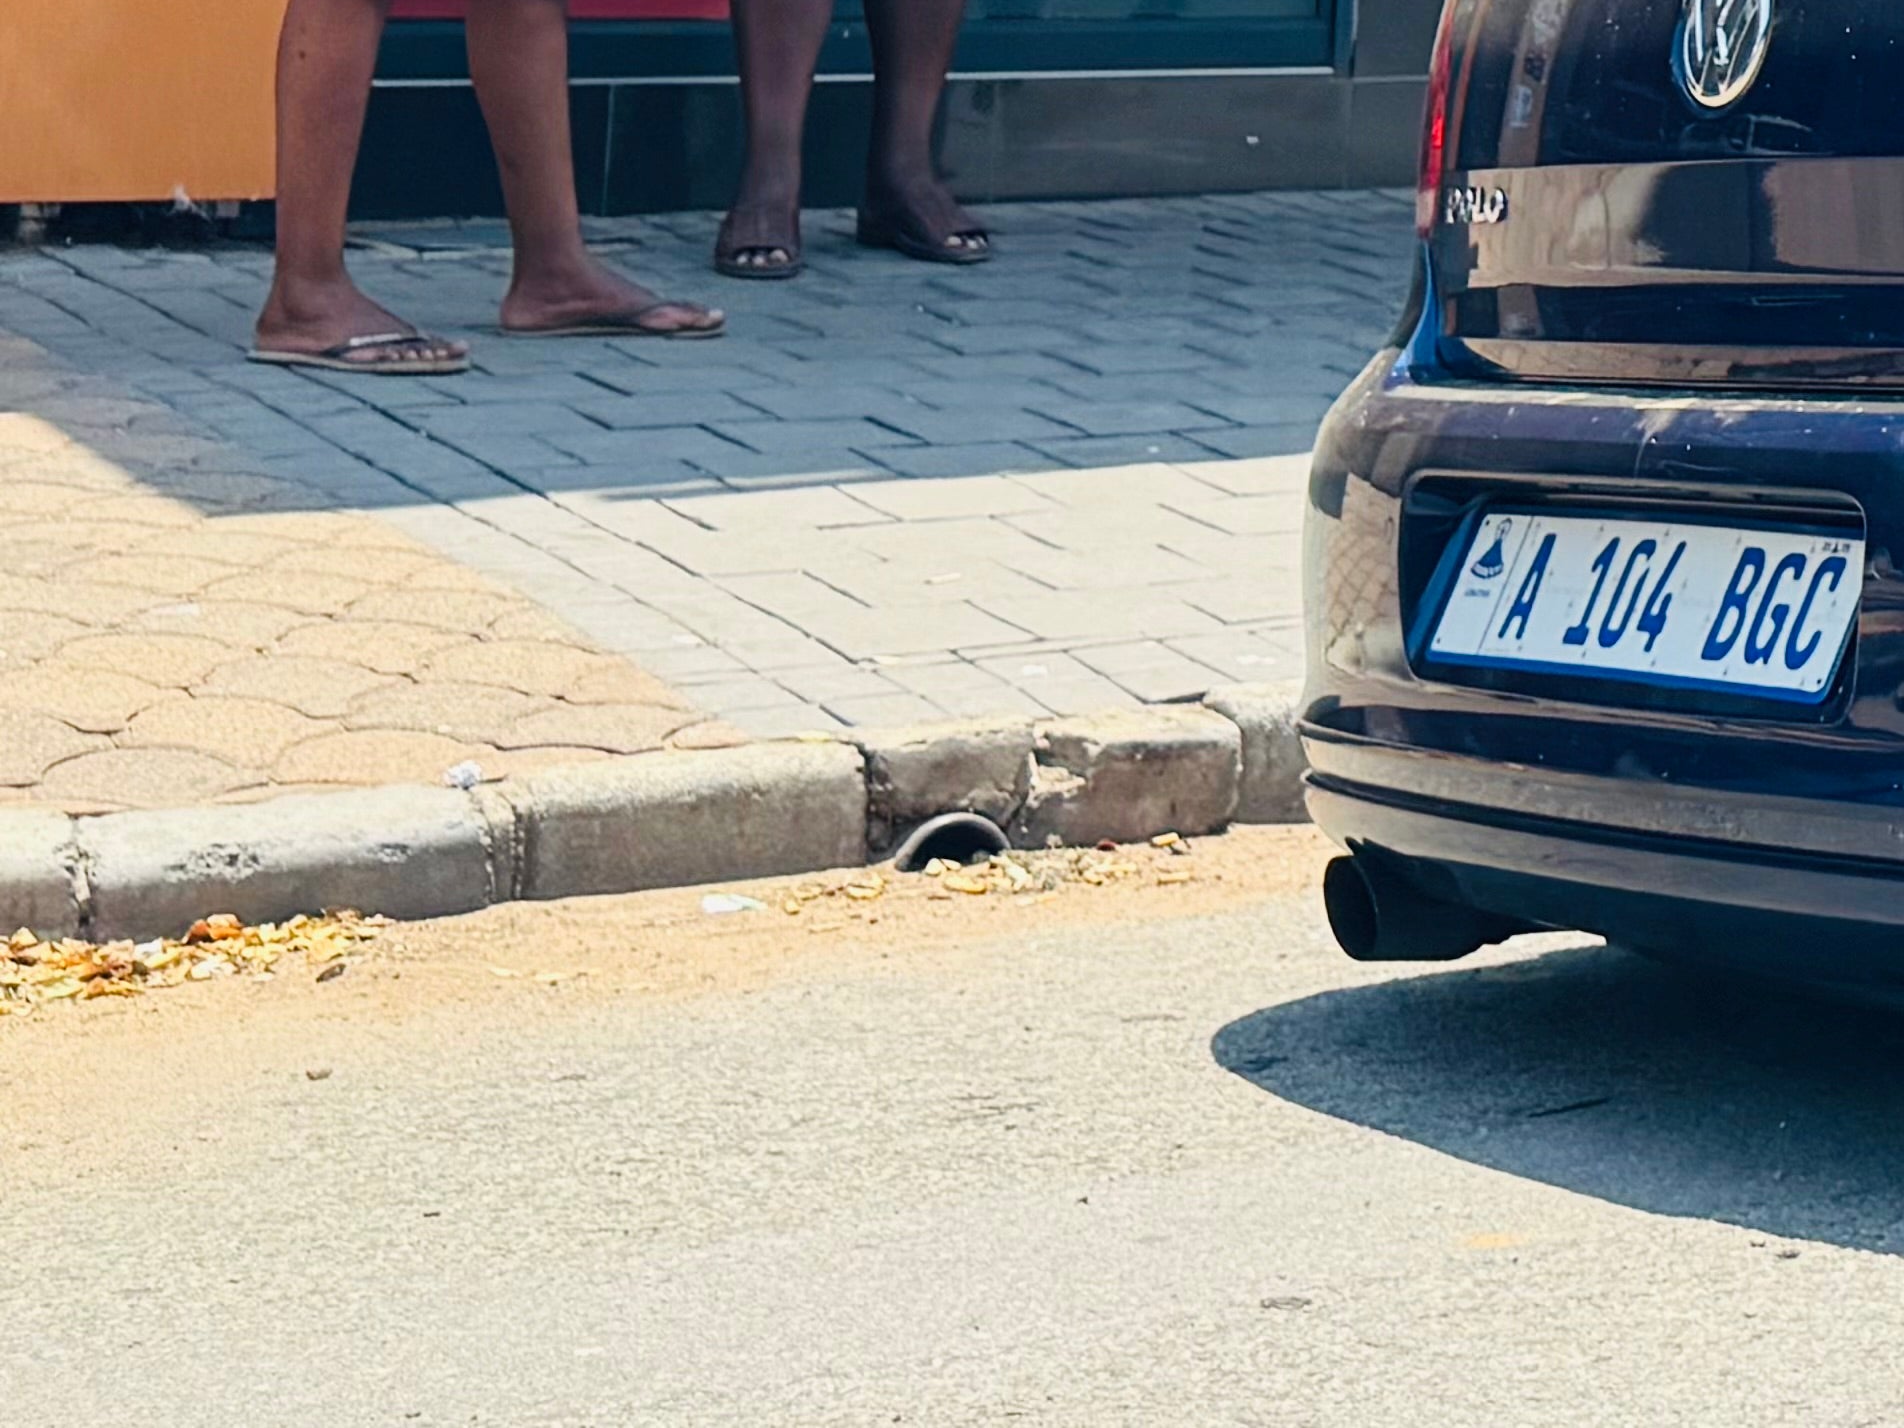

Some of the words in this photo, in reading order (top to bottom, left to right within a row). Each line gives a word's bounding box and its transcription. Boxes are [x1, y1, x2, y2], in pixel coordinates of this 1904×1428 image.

[1446, 187, 1508, 224] POLO
[1499, 533, 1556, 641] A
[1562, 536, 1687, 653] 104
[1700, 546, 1847, 670] BGC
